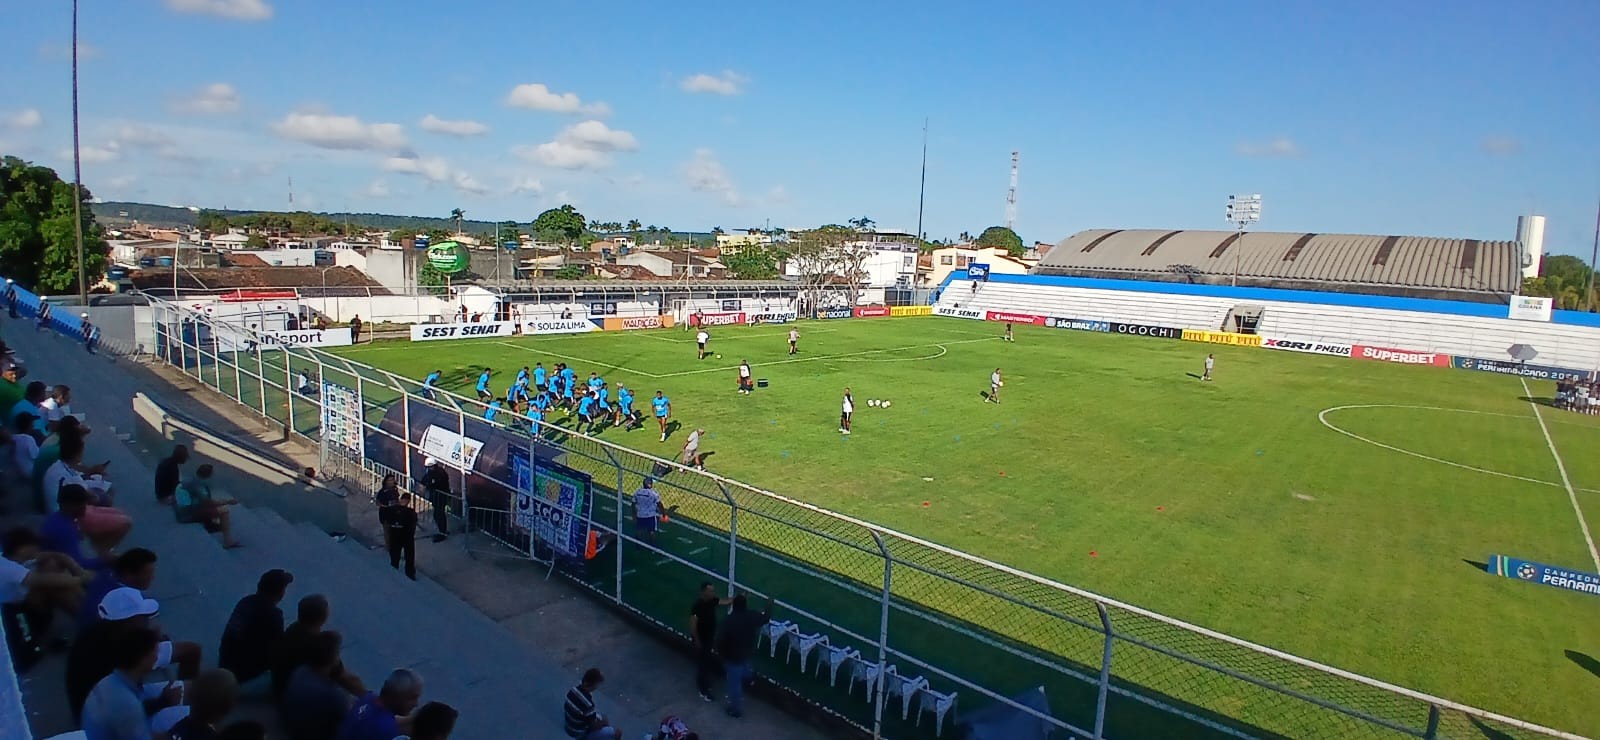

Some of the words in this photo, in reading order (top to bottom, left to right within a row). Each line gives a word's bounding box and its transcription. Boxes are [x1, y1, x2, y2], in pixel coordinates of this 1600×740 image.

[537, 322, 567, 331] SOUZA
[567, 321, 586, 330] LIMA
[696, 314, 739, 325] UPERBET
[422, 326, 457, 338] SEST
[461, 324, 501, 336] SENAT
[1118, 324, 1175, 338] OGOCHI
[1265, 338, 1314, 350] XBRI
[1315, 343, 1351, 355] PNEUS
[1362, 347, 1436, 364] SUPERBET
